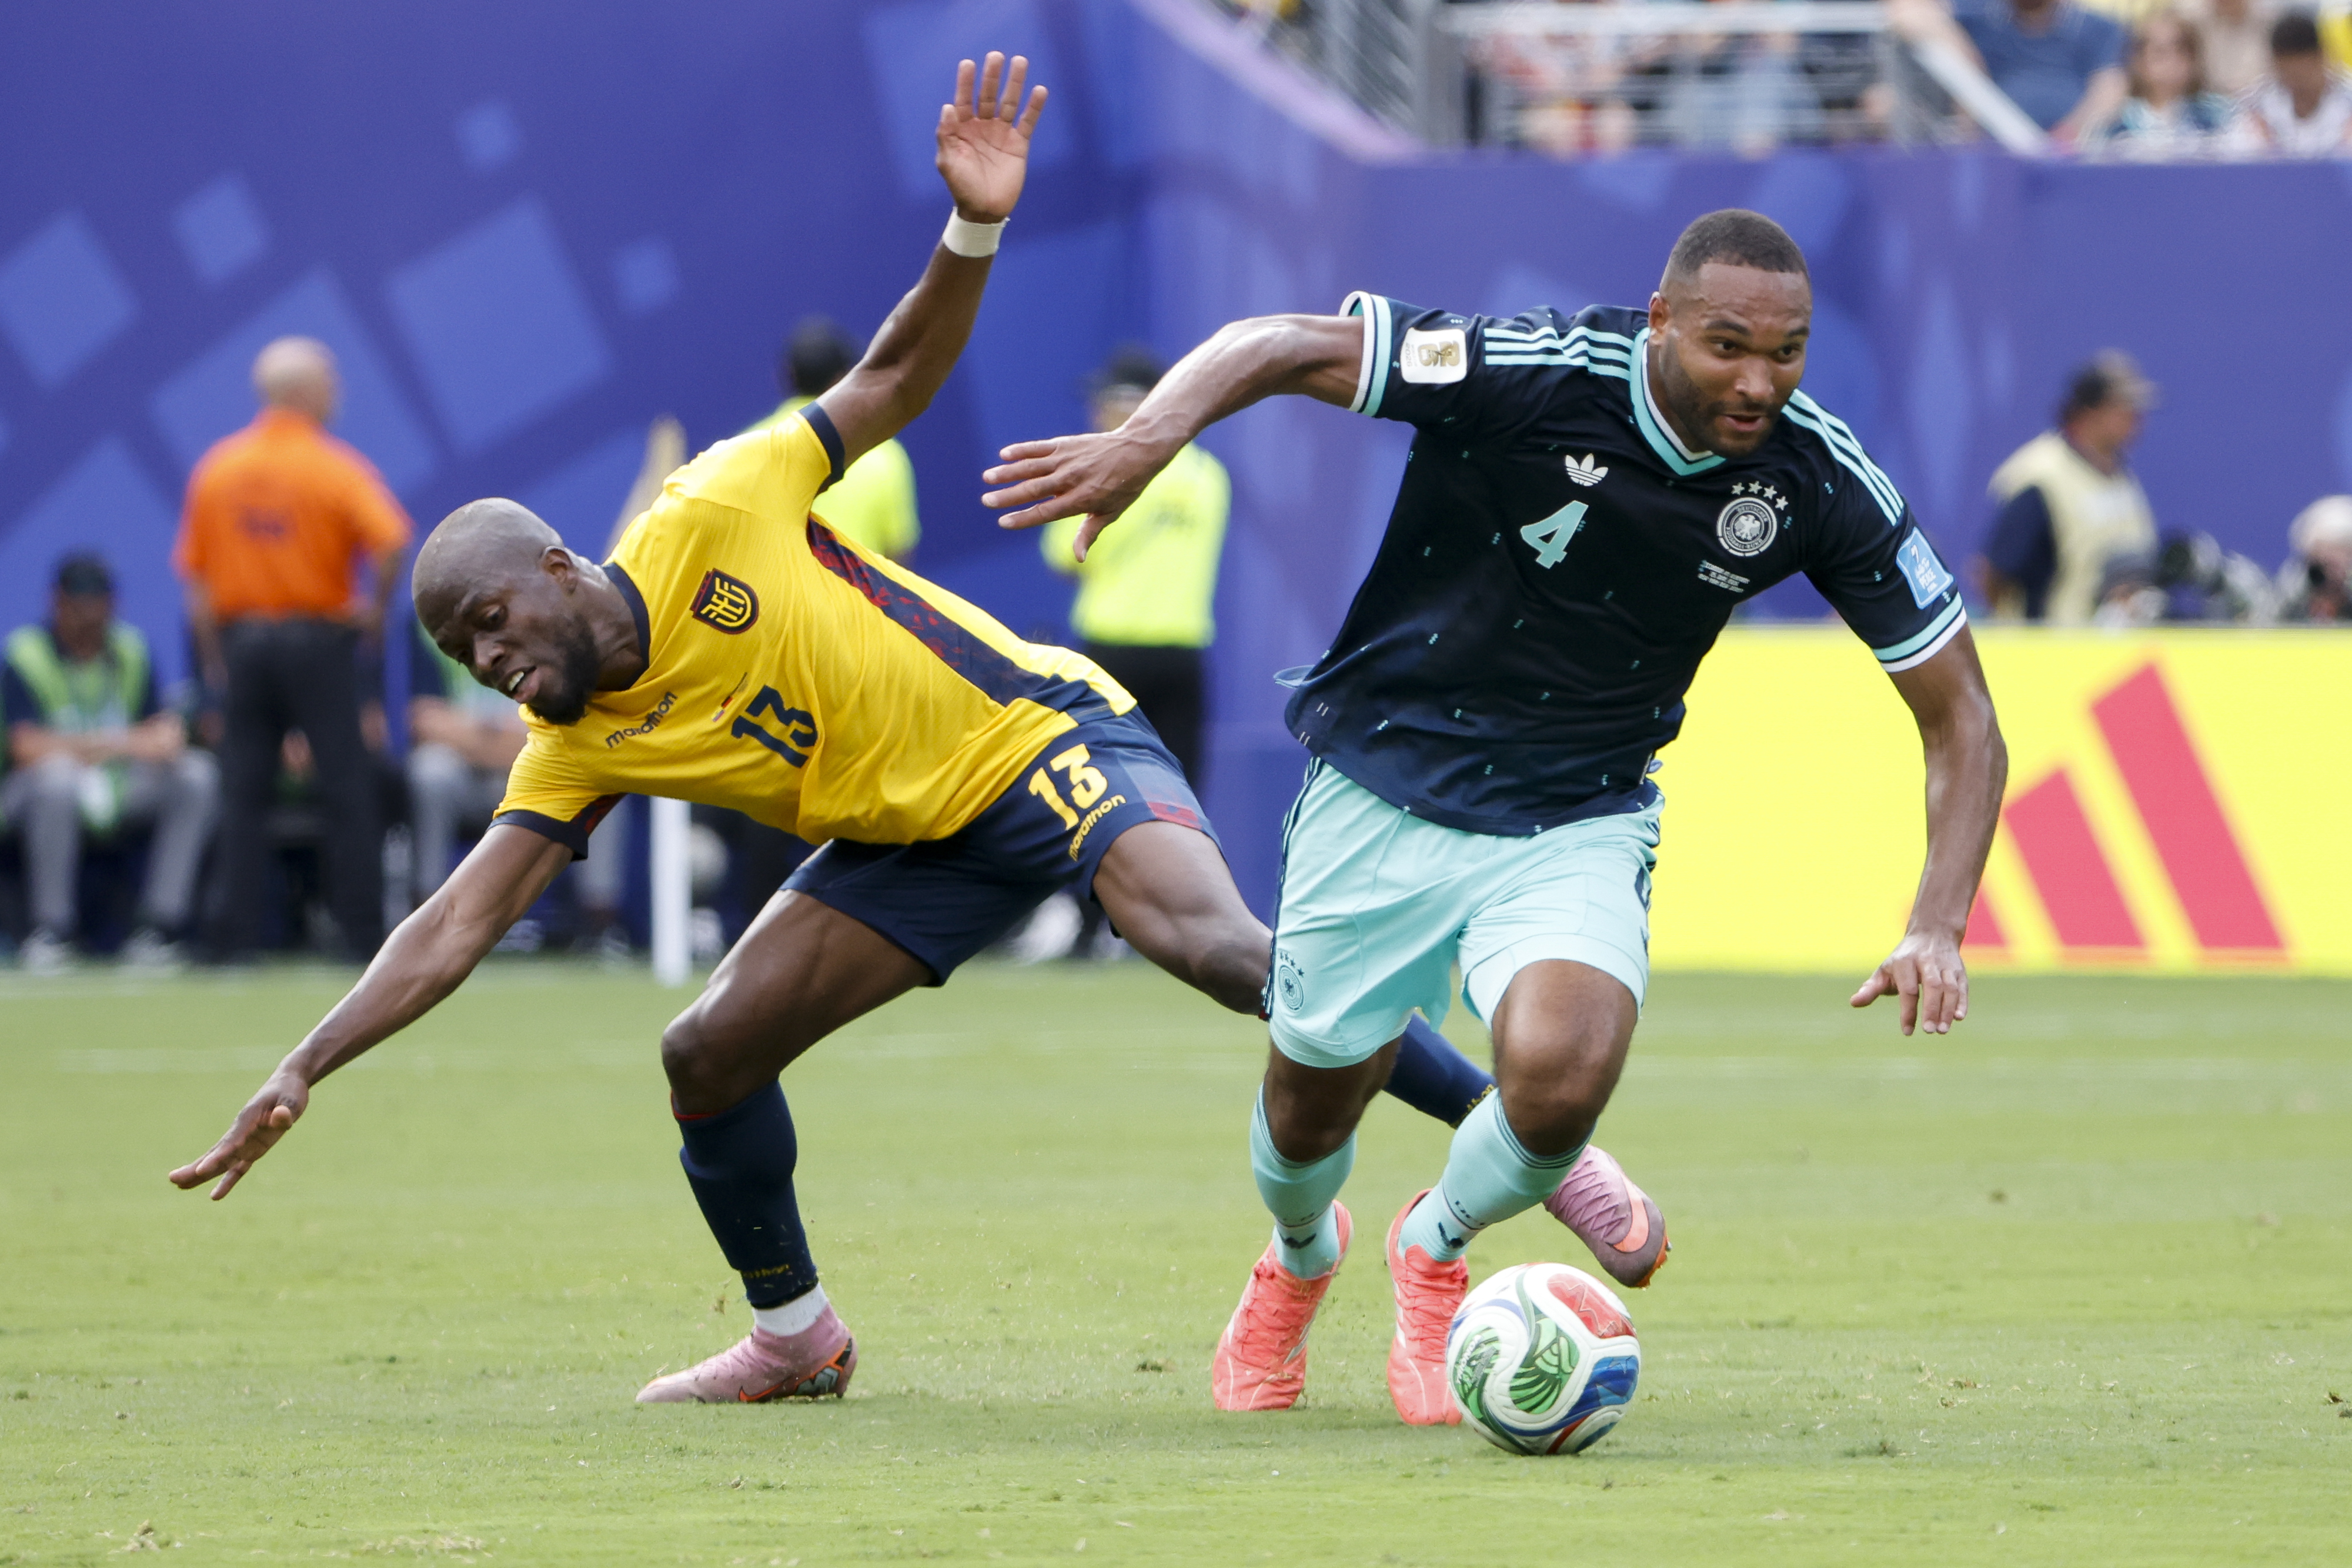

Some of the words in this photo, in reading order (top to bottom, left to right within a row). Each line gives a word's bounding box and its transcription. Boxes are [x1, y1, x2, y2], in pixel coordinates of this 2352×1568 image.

[1520, 500, 1589, 569] 4
[606, 691, 678, 748] marathon
[731, 685, 818, 768] 13
[1028, 743, 1108, 830] 13
[1068, 794, 1127, 862] marathon
